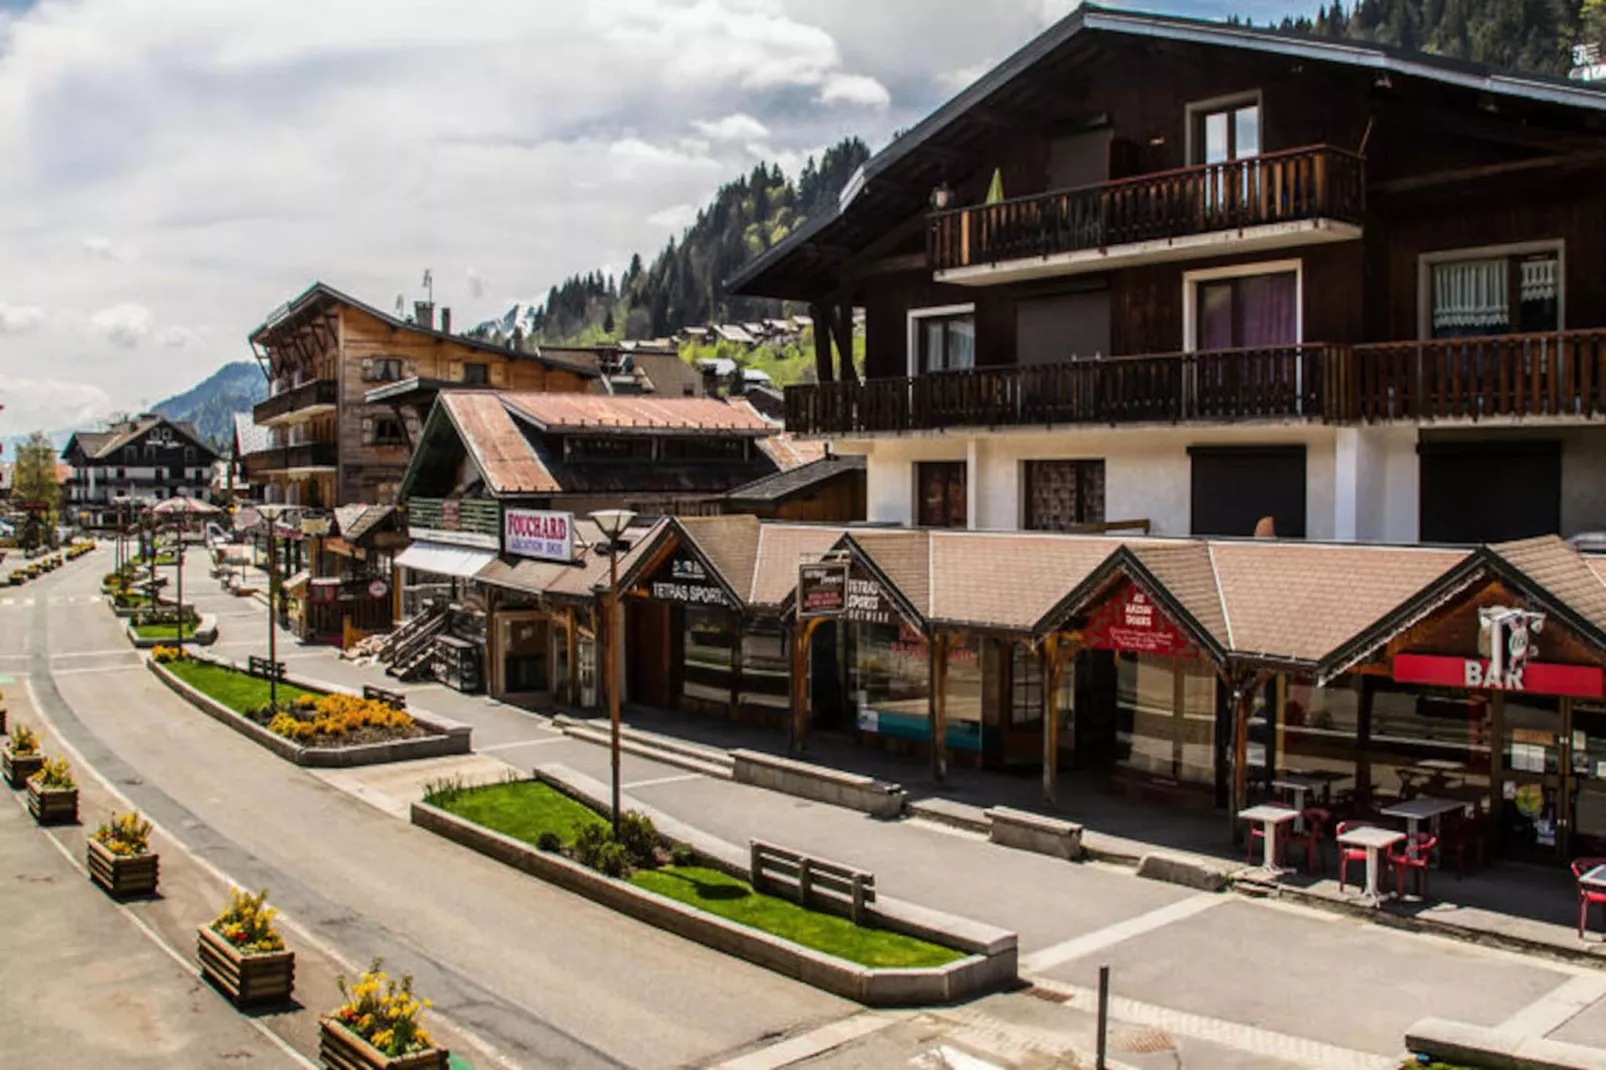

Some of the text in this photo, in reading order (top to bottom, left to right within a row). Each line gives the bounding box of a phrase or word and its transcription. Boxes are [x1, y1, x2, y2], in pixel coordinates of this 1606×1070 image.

[508, 512, 567, 540] FOUCHARD
[653, 582, 689, 601] TETRAS
[1464, 659, 1524, 691] BAR
